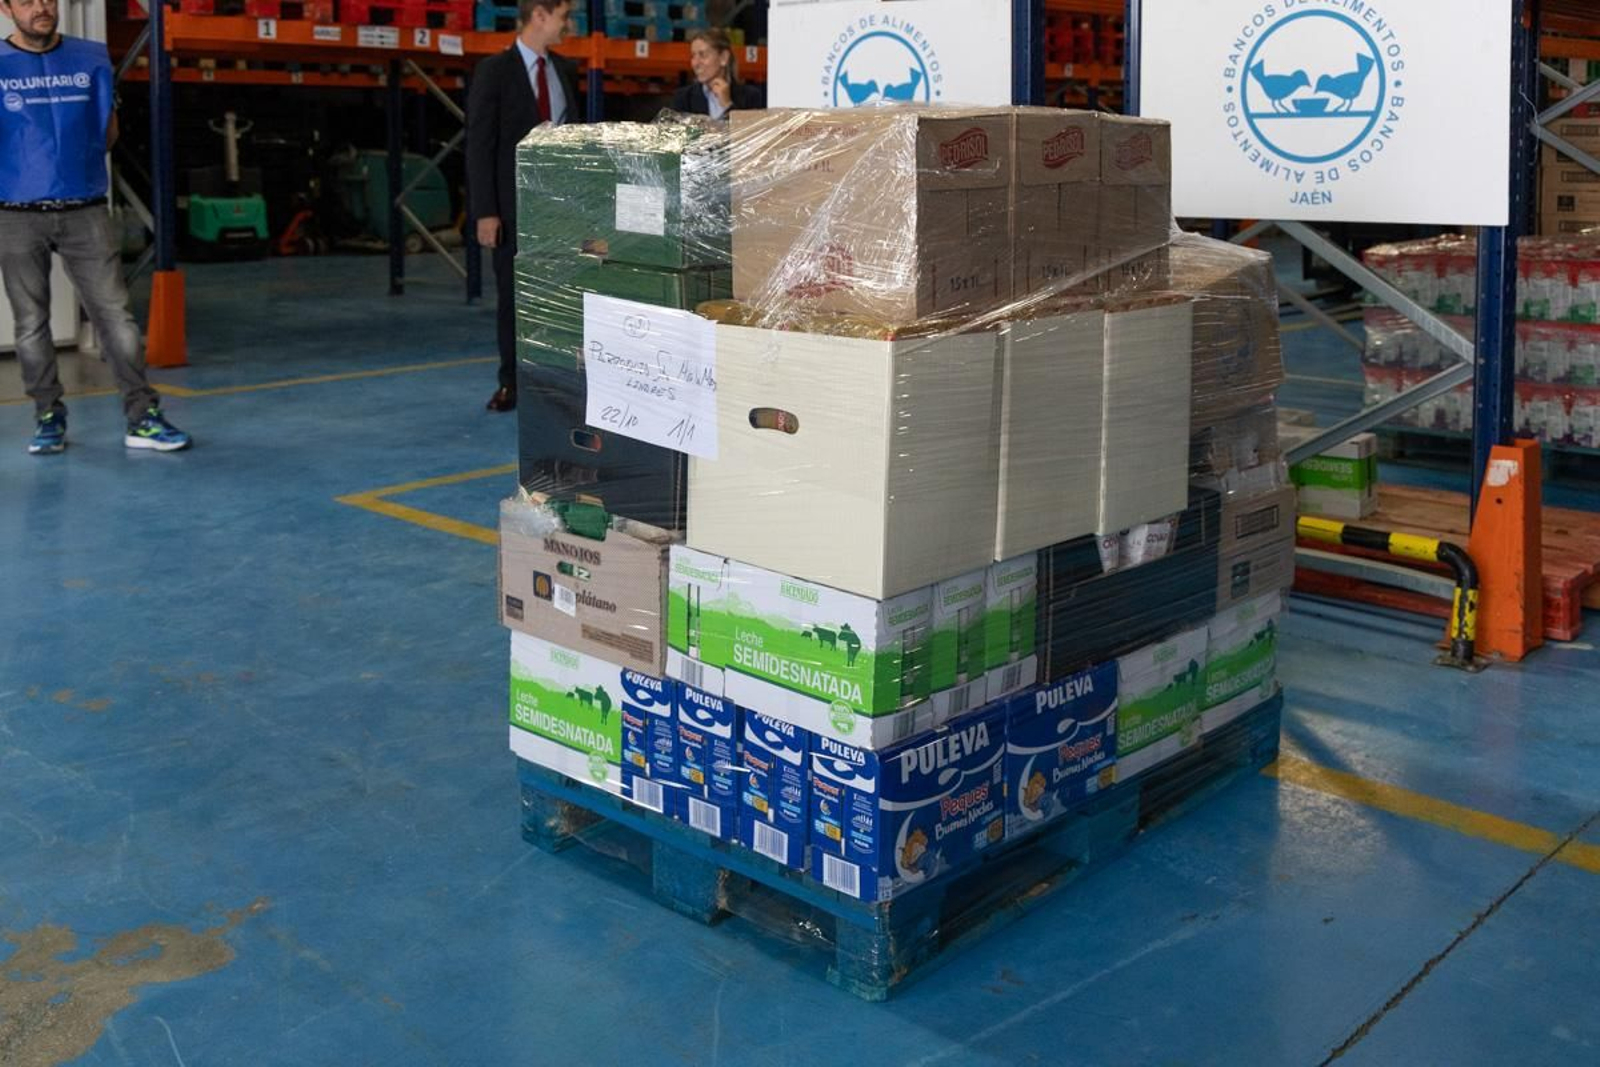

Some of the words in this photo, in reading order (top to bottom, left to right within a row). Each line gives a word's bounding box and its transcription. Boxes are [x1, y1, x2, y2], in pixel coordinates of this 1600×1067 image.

[417, 29, 426, 45] 2
[821, 25, 856, 86] BANCOS
[859, 14, 876, 29] DE
[882, 14, 943, 84] ALIMENTOS
[1224, 4, 1276, 79] BANCOS
[1316, 0, 1405, 71] IMENTOS
[0, 72, 91, 91] VOLUNTARI@
[1223, 101, 1306, 184] ALIMENTOS
[1348, 96, 1405, 172] BANCOS
[1315, 167, 1340, 184] DE
[1290, 188, 1333, 206] JAÉN
[544, 537, 602, 566] MANOJOS
[735, 626, 764, 648] Leche
[625, 671, 663, 692] PULEVA
[733, 644, 863, 706] SEMIDESNATADA
[515, 689, 539, 707] Leche
[685, 687, 724, 713] PULEVA
[1036, 674, 1094, 715] PULEVA
[515, 703, 614, 756] SEMIDESNATADA
[755, 712, 796, 738] PULEVA
[821, 737, 866, 766] PULEVA
[901, 722, 990, 785] PULEVA
[939, 780, 990, 822] Peques
[935, 815, 969, 842] Buenas
